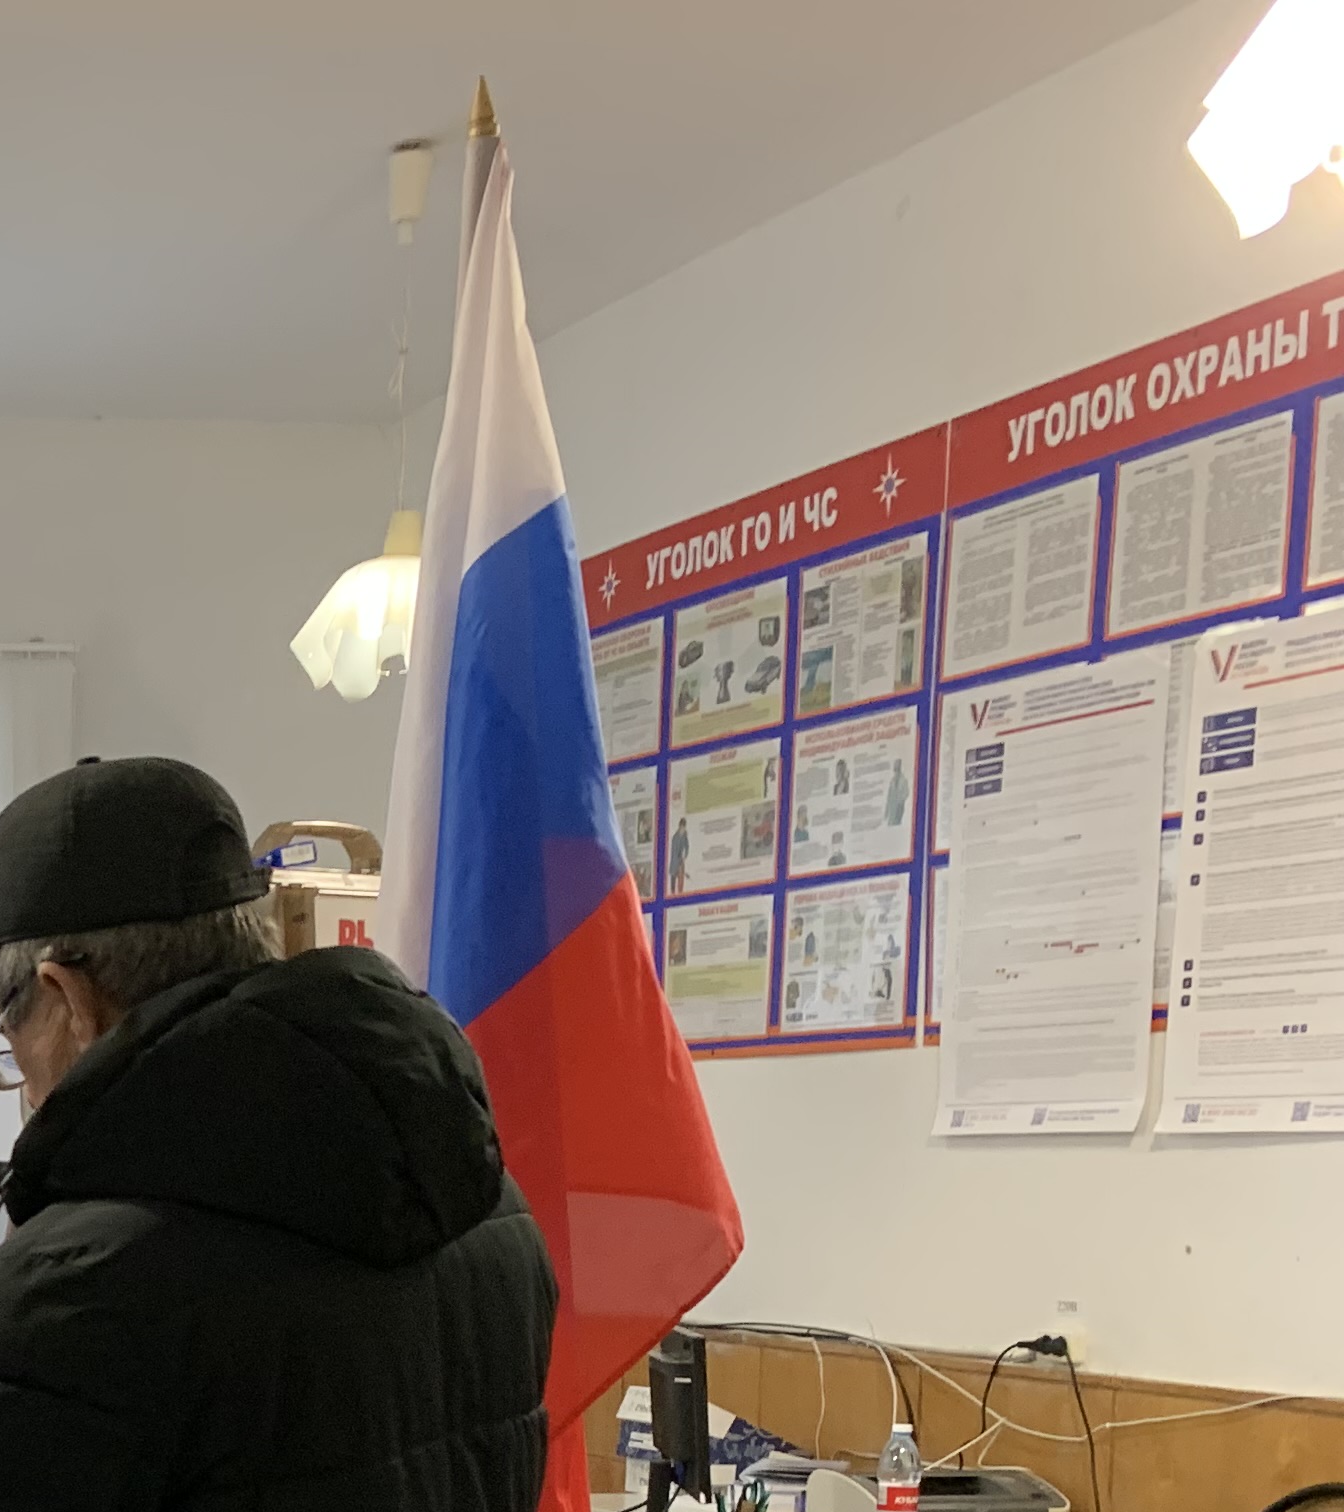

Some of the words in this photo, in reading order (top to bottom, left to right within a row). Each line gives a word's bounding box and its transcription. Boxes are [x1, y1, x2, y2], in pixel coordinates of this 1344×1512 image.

[1007, 373, 1137, 463] УГОЛОК
[1146, 309, 1309, 411] ОХРАНЫ
[1321, 296, 1344, 349] Т
[645, 524, 735, 590] УГОЛОК
[741, 511, 771, 557] ГО
[778, 501, 796, 544] И
[803, 487, 838, 532] ЧС
